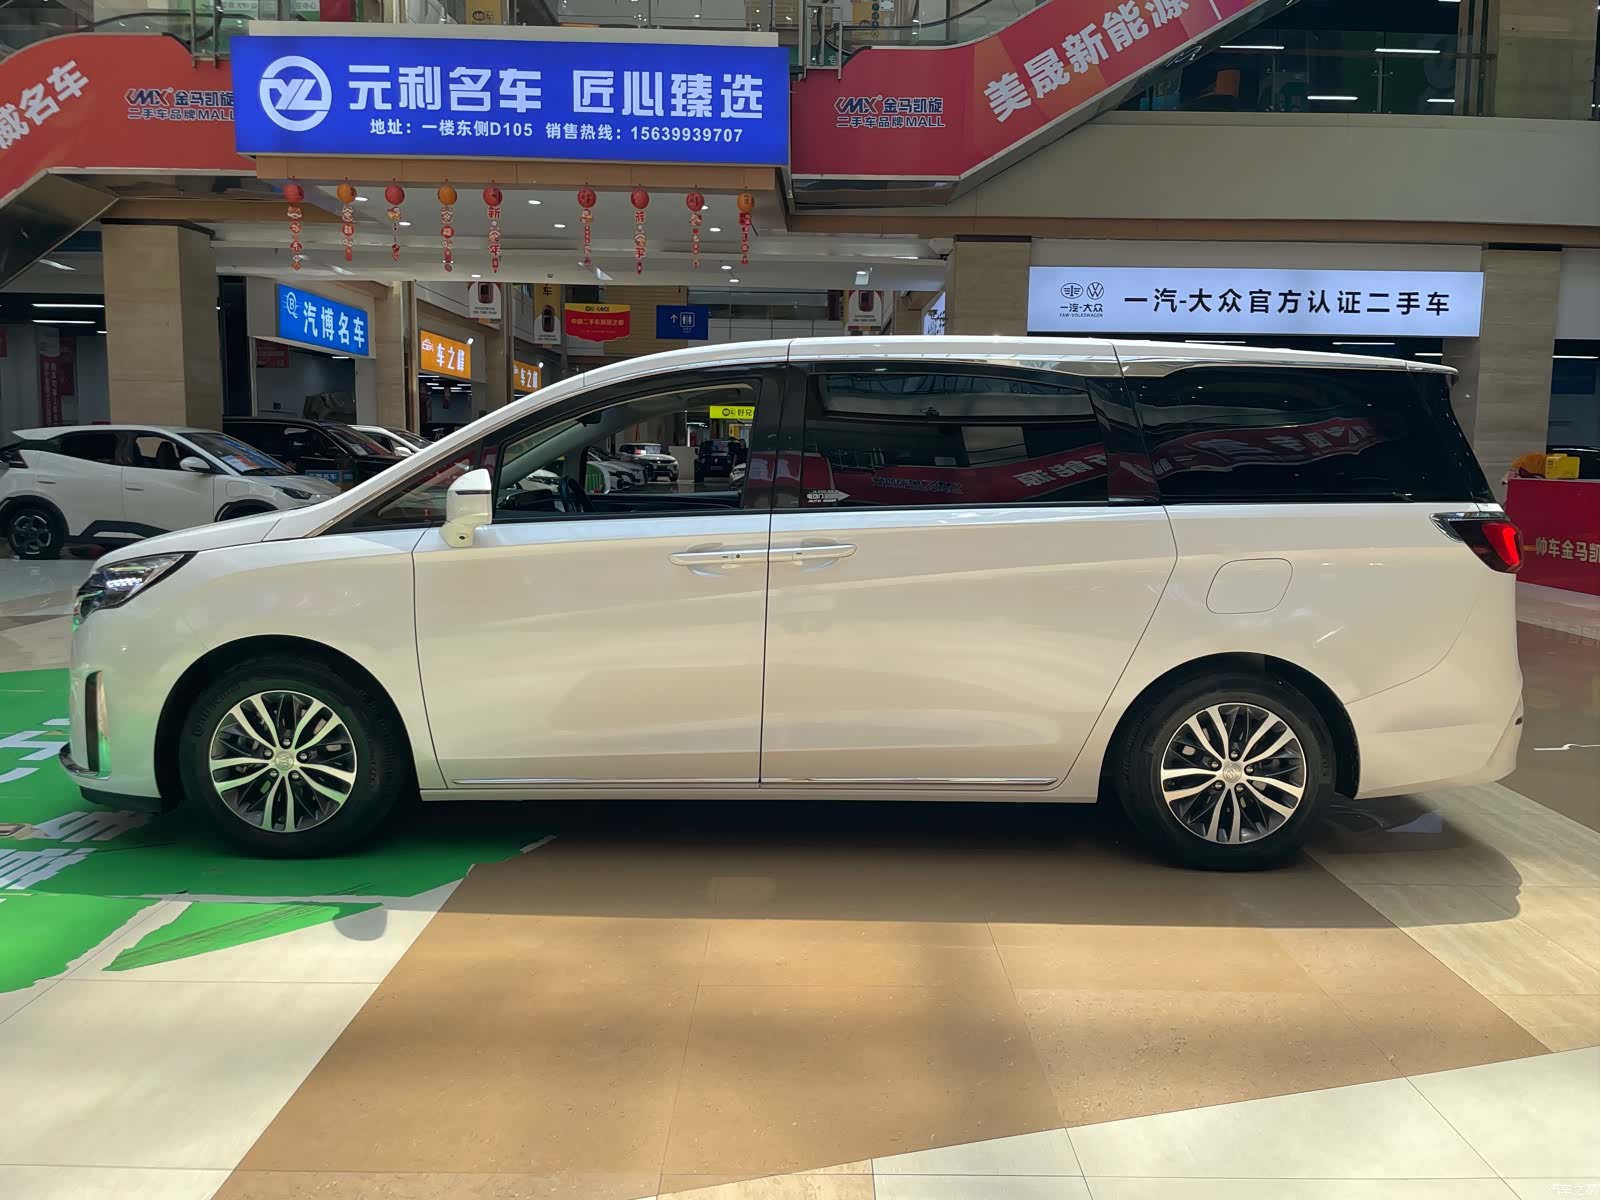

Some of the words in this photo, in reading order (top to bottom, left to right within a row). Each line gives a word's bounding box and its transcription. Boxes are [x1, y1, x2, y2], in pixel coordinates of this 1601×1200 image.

[174, 91, 234, 107] 金马凯旋
[349, 65, 542, 113] 元利名车
[573, 70, 763, 119] 匠心臻选
[883, 97, 943, 114] 金马凯旋
[1124, 287, 1450, 316] 一汽-大众官方认证二手车
[303, 301, 365, 348] 汽博名车
